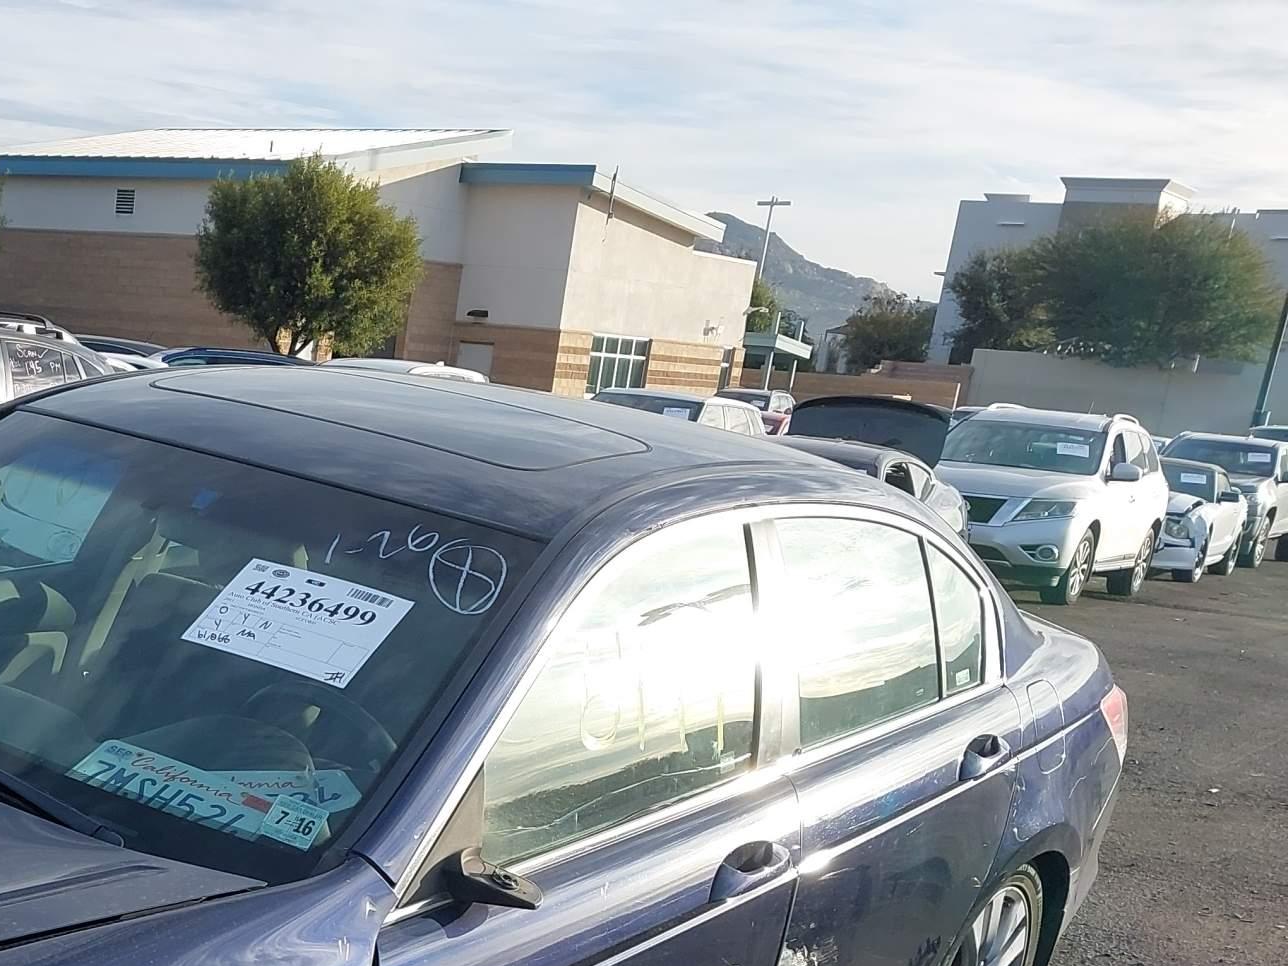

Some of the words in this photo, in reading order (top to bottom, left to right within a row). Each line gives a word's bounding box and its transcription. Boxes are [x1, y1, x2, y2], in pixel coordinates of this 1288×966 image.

[231, 591, 245, 600] Auto
[245, 595, 262, 605] Club
[270, 602, 301, 615] Southern
[244, 580, 377, 627] 44236499
[131, 756, 241, 805] California
